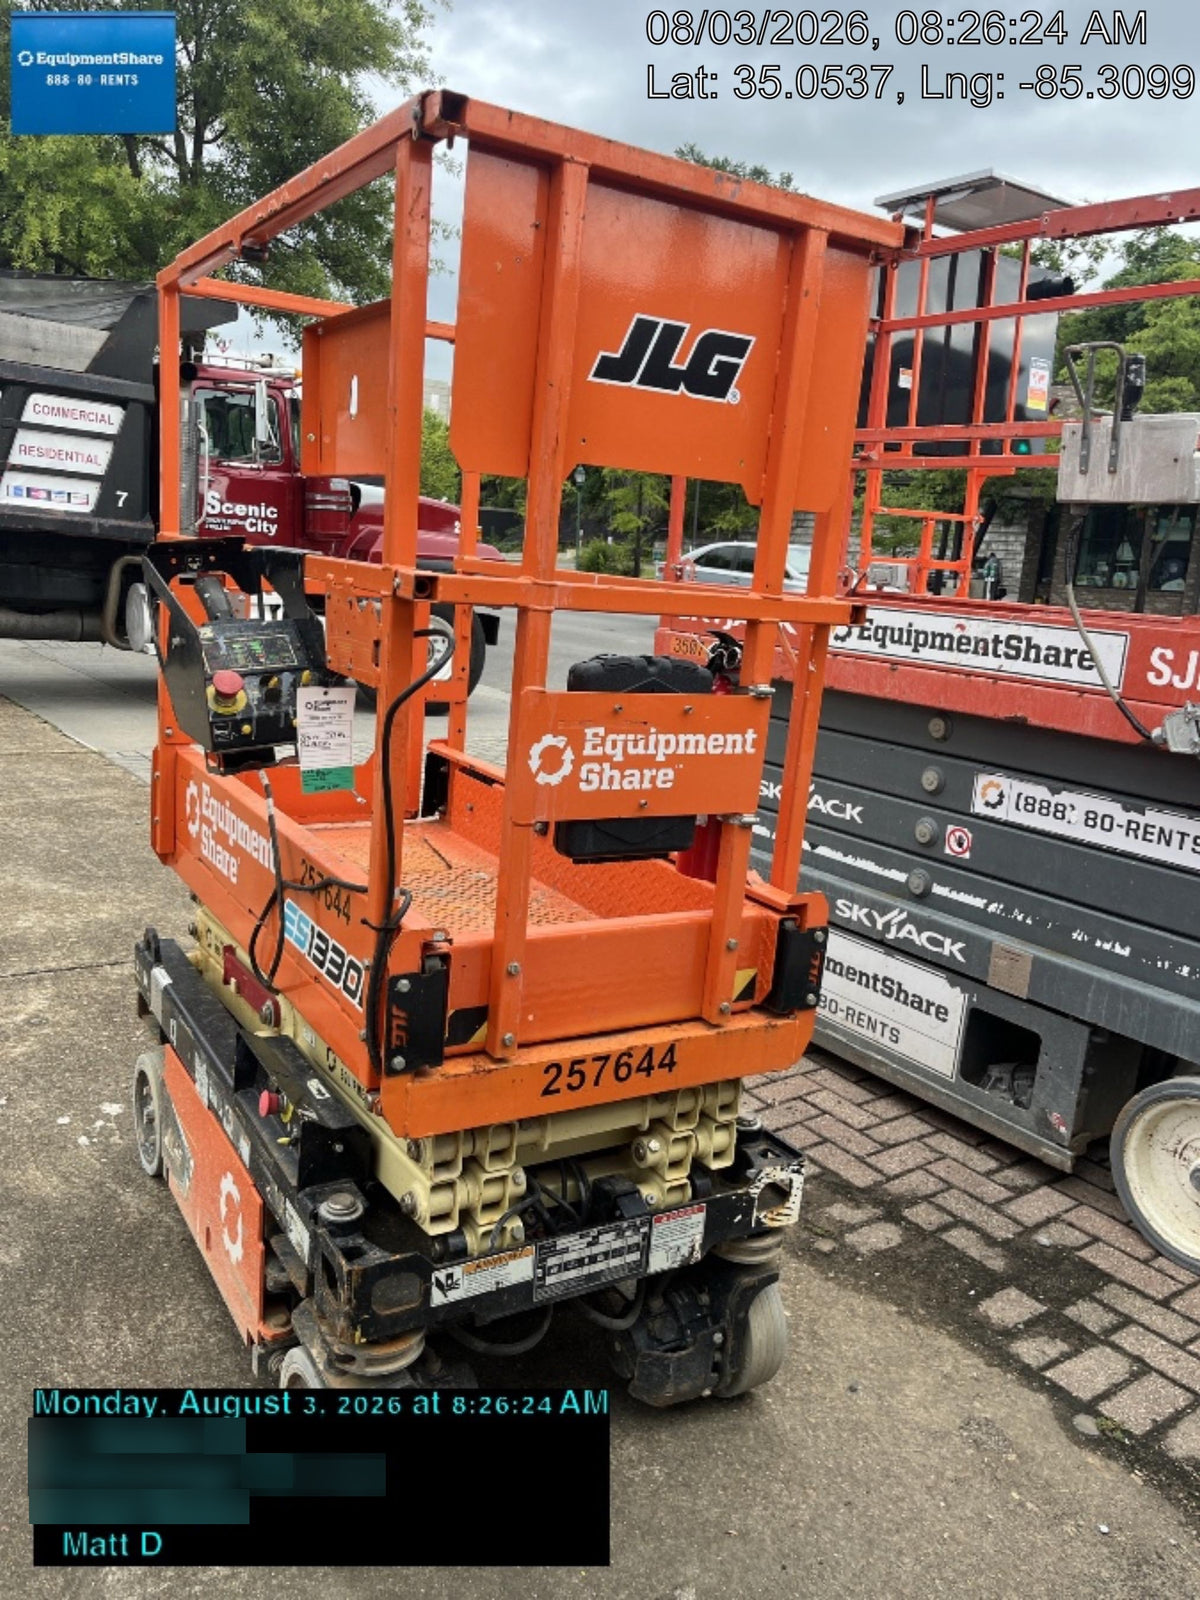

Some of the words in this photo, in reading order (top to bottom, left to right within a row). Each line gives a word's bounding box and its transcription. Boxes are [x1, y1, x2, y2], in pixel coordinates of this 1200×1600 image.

[586, 313, 756, 403] JLG
[33, 403, 114, 426] COMMERCIAL
[19, 444, 102, 467] RESIDENTIAL
[116, 490, 129, 507] 7
[206, 490, 278, 519] Scenic
[245, 517, 278, 536] City
[857, 618, 1097, 671] EquipmentShare
[1146, 646, 1200, 690] SJ
[582, 726, 758, 762] Equipment
[579, 762, 675, 792] Share
[758, 780, 864, 824] SKACK
[201, 822, 238, 885] Share
[835, 899, 967, 963] SKYJACK
[284, 898, 364, 1012] ES1330
[540, 1043, 677, 1097] 257644
